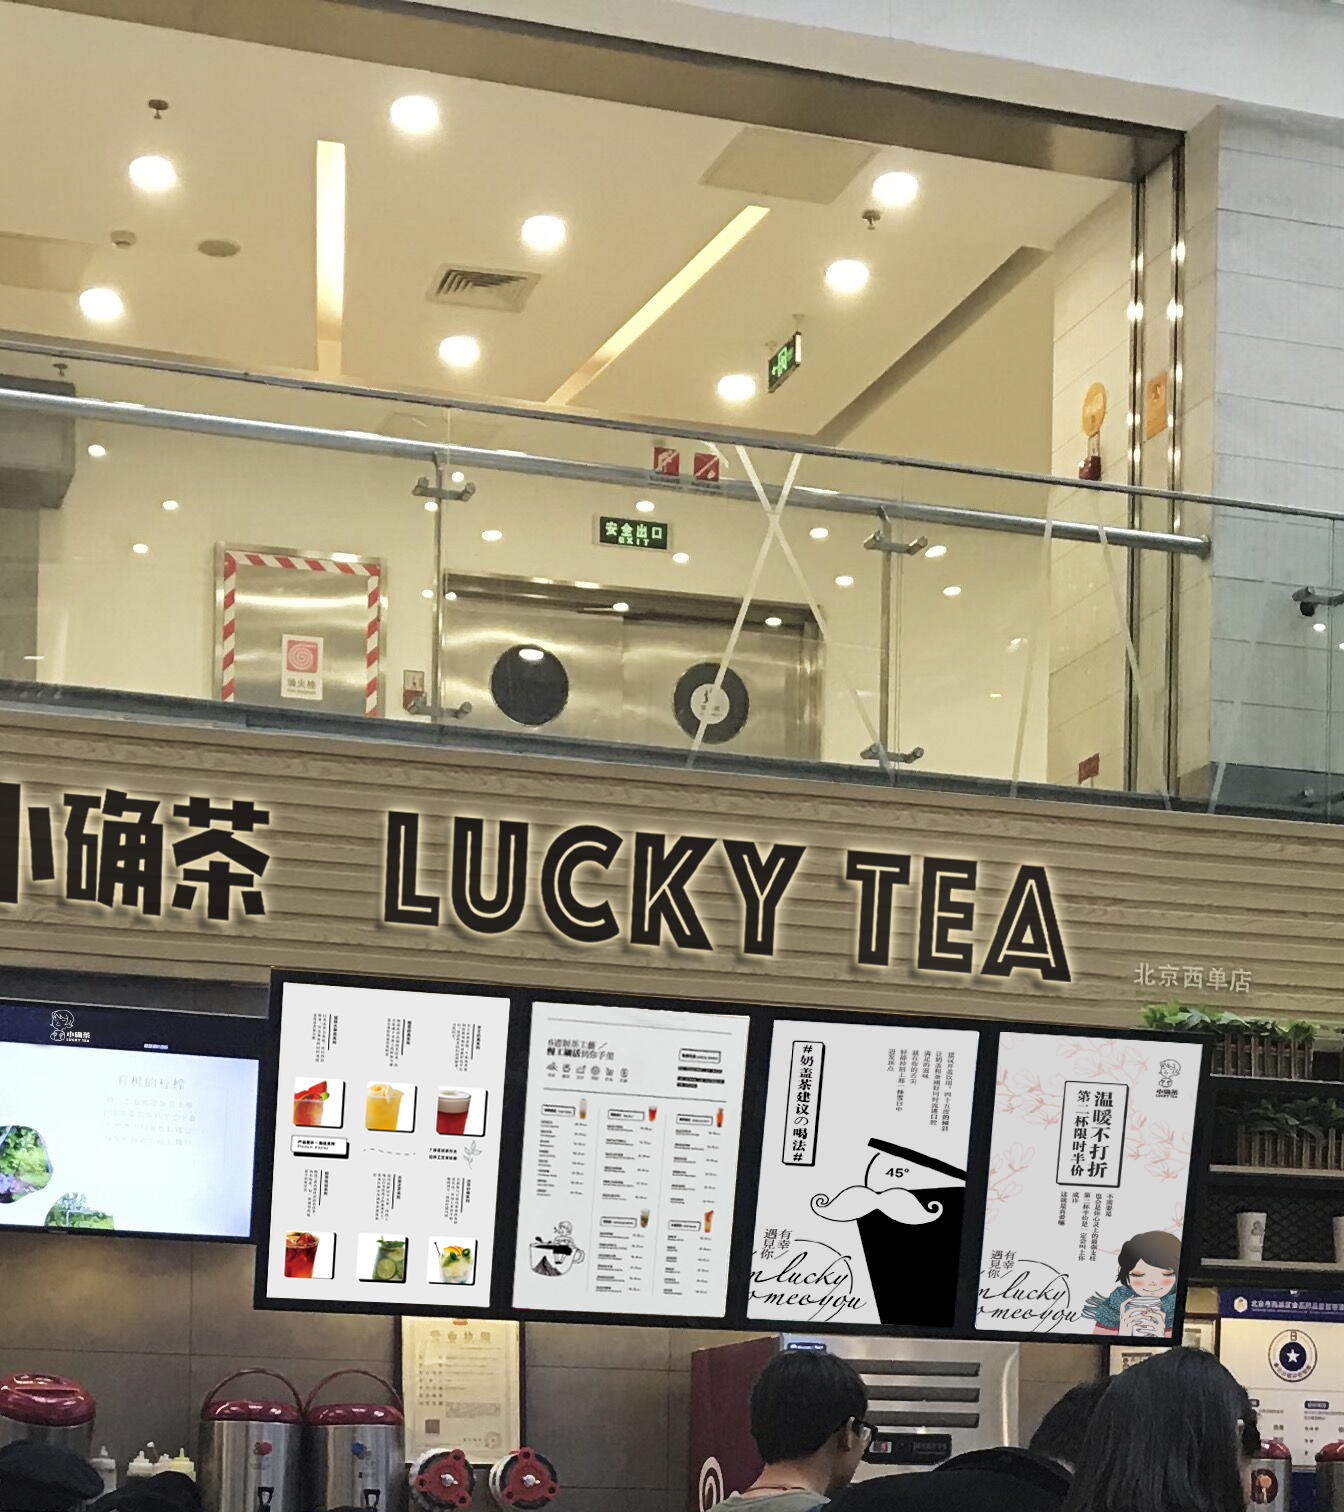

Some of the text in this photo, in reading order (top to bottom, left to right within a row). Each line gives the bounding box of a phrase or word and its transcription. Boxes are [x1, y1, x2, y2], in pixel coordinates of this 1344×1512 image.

[605, 521, 662, 539] 安全出口
[618, 536, 649, 546] EXIT
[384, 811, 1072, 982] LUCKY TEA
[1133, 962, 1253, 993] 北京西单店
[791, 1044, 814, 1162] #奶盖茶建议の喝法#
[1070, 1090, 1091, 1178] 第二杯限时半价
[1087, 1091, 1114, 1179] 温暖不打折
[885, 1168, 909, 1178] 45°
[760, 1228, 778, 1260] 遇見你
[777, 1229, 793, 1250] 有幸
[987, 1250, 1004, 1279] 遇見你
[1003, 1250, 1017, 1271] 有幸
[776, 1251, 852, 1304] lucky
[1001, 1271, 1069, 1319] lucky
